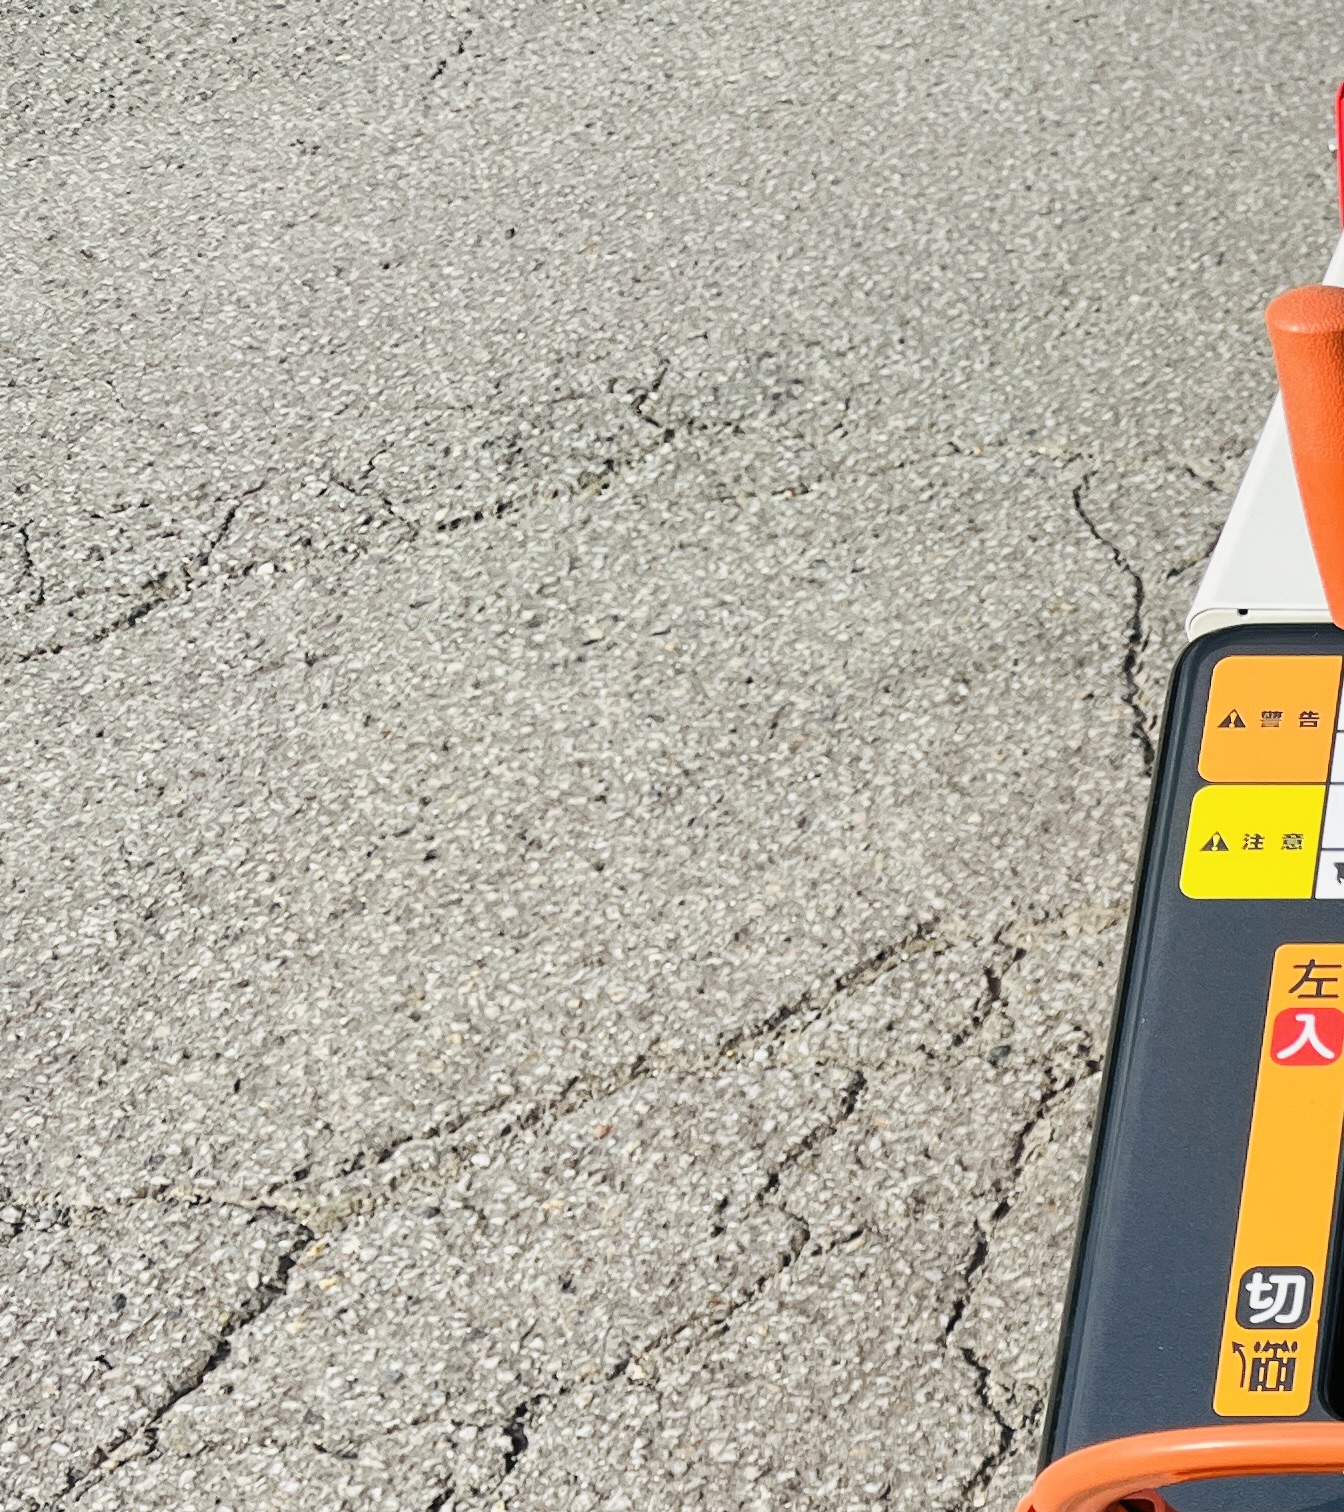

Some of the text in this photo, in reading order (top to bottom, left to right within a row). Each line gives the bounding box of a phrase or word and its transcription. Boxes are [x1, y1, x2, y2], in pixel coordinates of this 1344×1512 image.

[1260, 711, 1320, 728] 警告
[1242, 833, 1304, 850] 注意
[1288, 959, 1343, 999] 左
[1276, 1014, 1335, 1060] 入
[1246, 1273, 1306, 1323] 切
